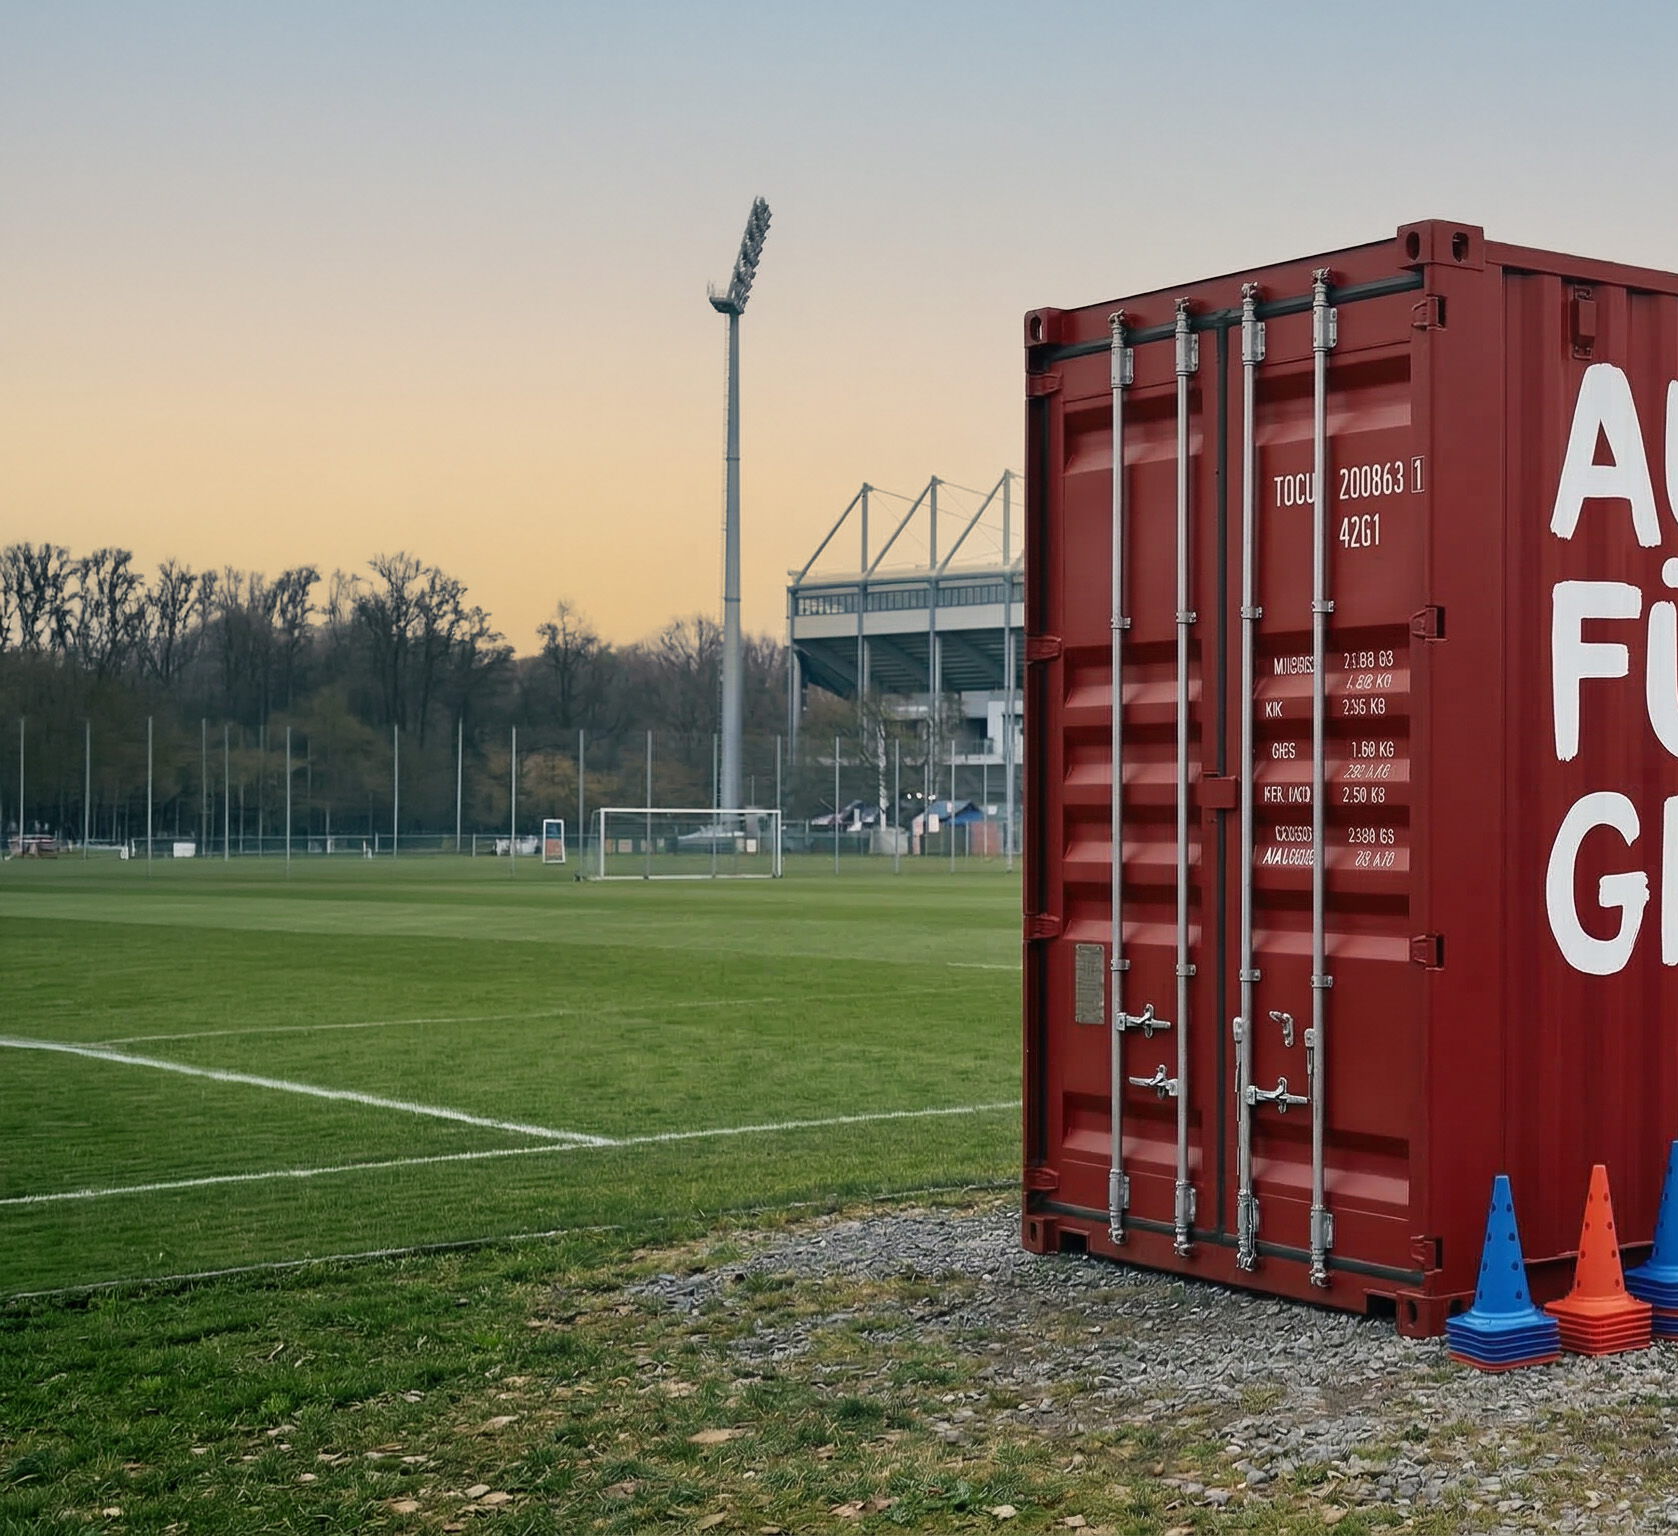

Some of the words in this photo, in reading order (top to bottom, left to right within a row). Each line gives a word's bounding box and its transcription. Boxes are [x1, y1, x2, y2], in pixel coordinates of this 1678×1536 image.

[1274, 473, 1316, 507] TOCU
[1339, 461, 1404, 500] 200863
[1412, 458, 1423, 491] 1
[1339, 513, 1380, 548] 42G1
